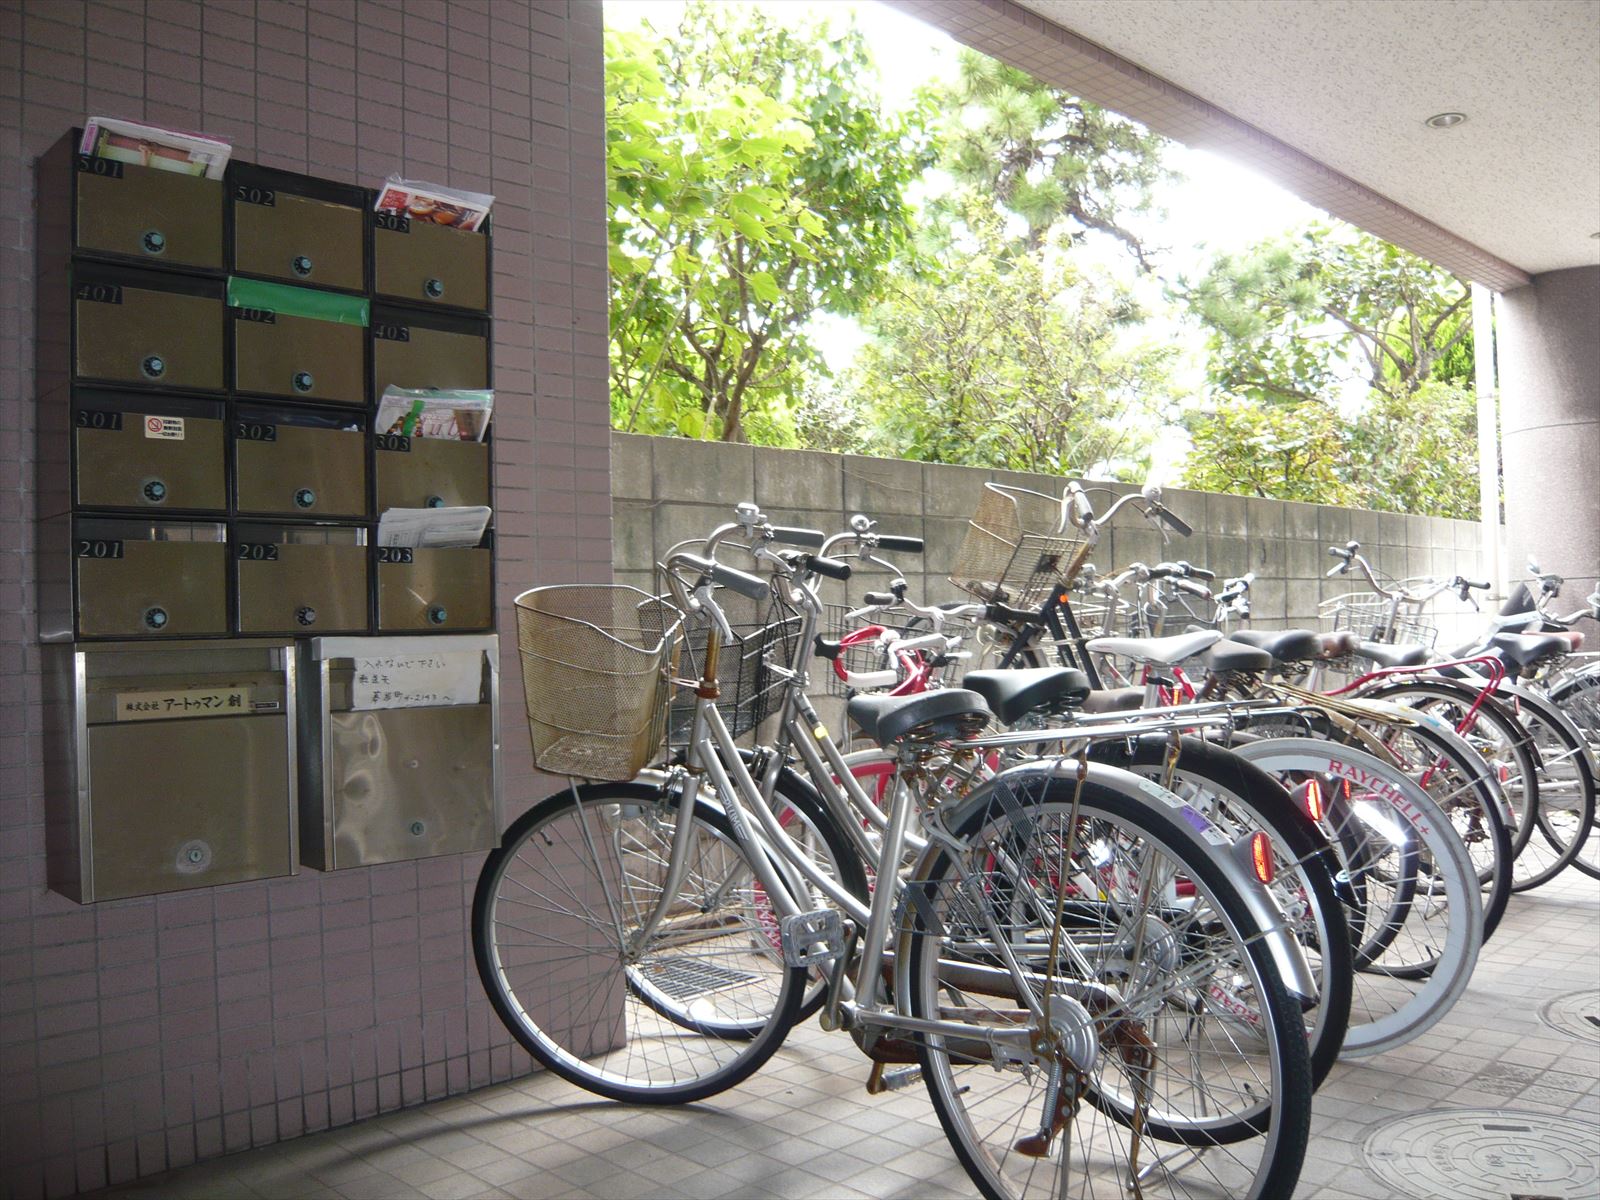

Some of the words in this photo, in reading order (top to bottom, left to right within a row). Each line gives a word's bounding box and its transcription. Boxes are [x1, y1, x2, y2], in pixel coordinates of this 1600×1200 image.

[79, 159, 120, 178] 501
[237, 185, 274, 206] 502
[377, 214, 408, 232] 503
[78, 285, 120, 303] 401
[375, 324, 409, 341] 403
[78, 411, 119, 430] 301
[238, 423, 274, 441] 302
[376, 435, 409, 451] 303
[80, 541, 121, 558] 201
[239, 544, 278, 560] 202
[379, 548, 412, 563] 203
[125, 700, 160, 711] 株式会社
